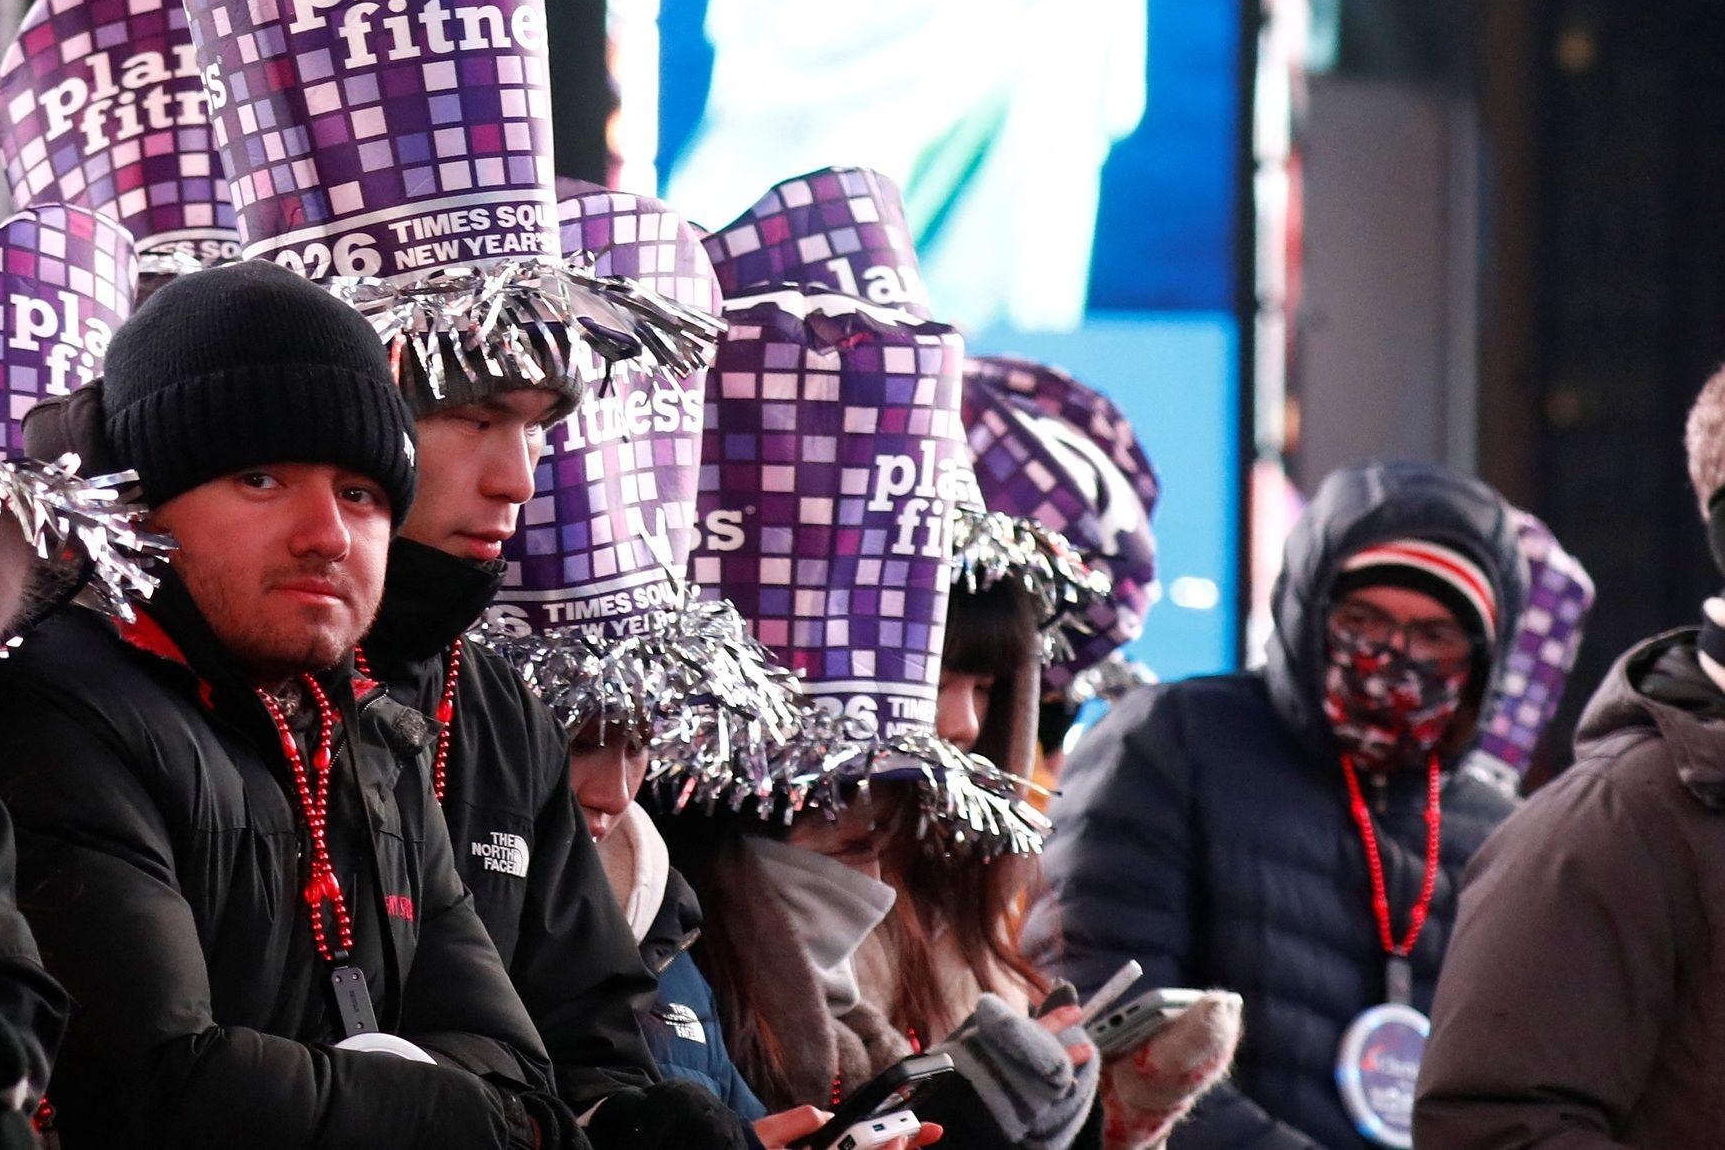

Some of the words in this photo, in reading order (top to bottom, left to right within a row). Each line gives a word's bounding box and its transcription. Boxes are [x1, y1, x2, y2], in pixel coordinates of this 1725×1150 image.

[388, 208, 491, 243] TIMES
[394, 242, 460, 270] NEW
[542, 592, 632, 623] TIMES
[471, 841, 516, 862] NORTH
[490, 831, 516, 848] THE
[484, 856, 517, 874] FACE
